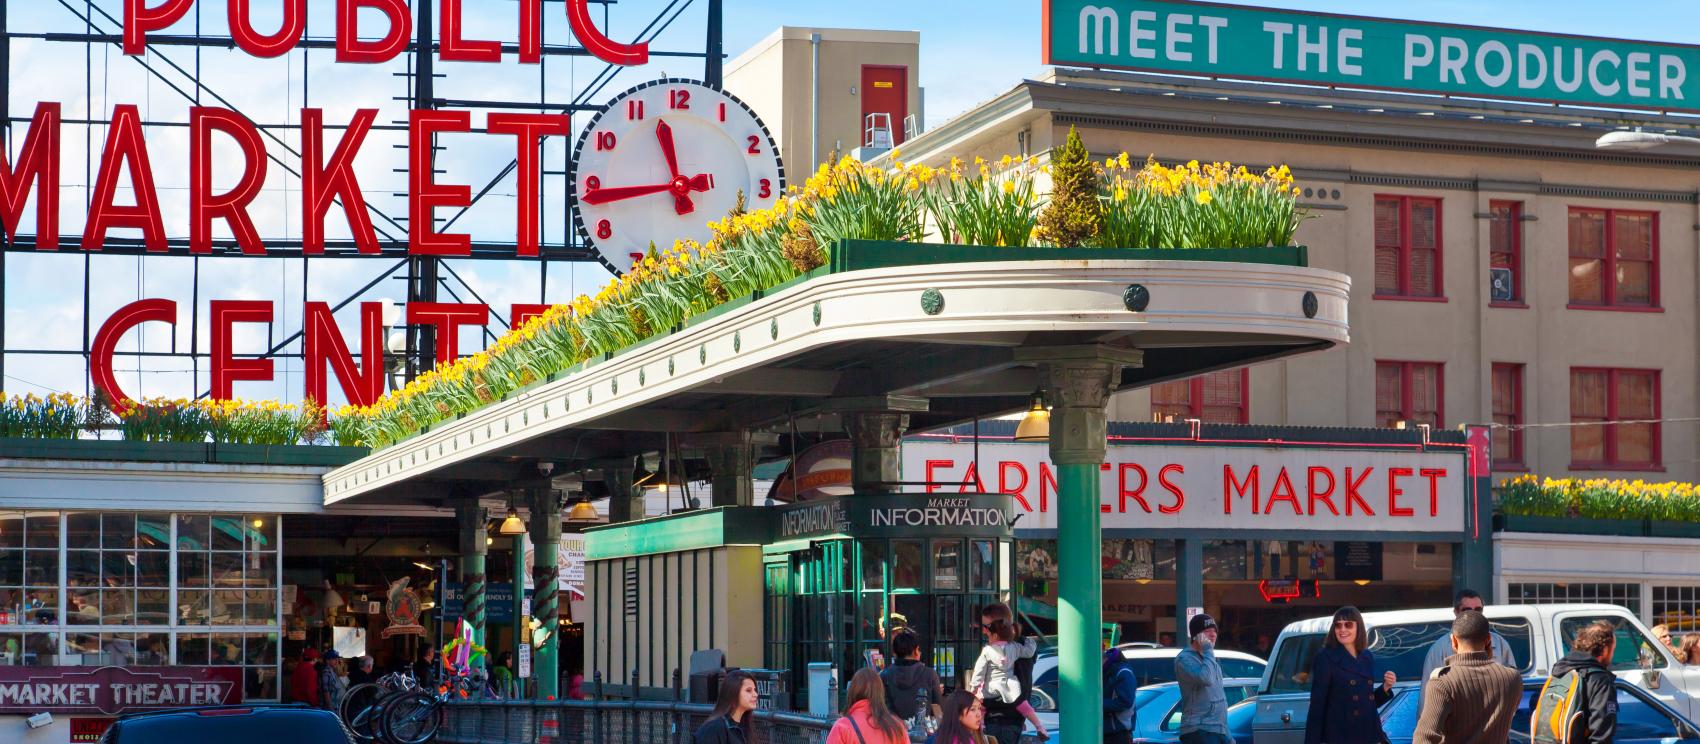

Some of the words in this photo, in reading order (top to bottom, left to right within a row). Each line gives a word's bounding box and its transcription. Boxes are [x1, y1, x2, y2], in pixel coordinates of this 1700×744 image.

[1078, 5, 1228, 65] MEET
[1263, 21, 1363, 76] THE
[1404, 34, 1687, 100] PRODUCER
[670, 89, 690, 109] 12
[628, 100, 644, 120] 11
[719, 103, 726, 122] 1
[597, 131, 616, 151] 10
[747, 135, 760, 154] 2
[0, 101, 571, 256] MARKET
[758, 178, 771, 199] 3
[597, 219, 612, 239] 8
[1223, 464, 1448, 517] MARKET
[927, 498, 970, 508] MARKET
[782, 505, 834, 536] INFORMATION
[871, 508, 1007, 527] INFORMATION
[0, 683, 100, 705] MARKET
[110, 683, 222, 705] THEATER
